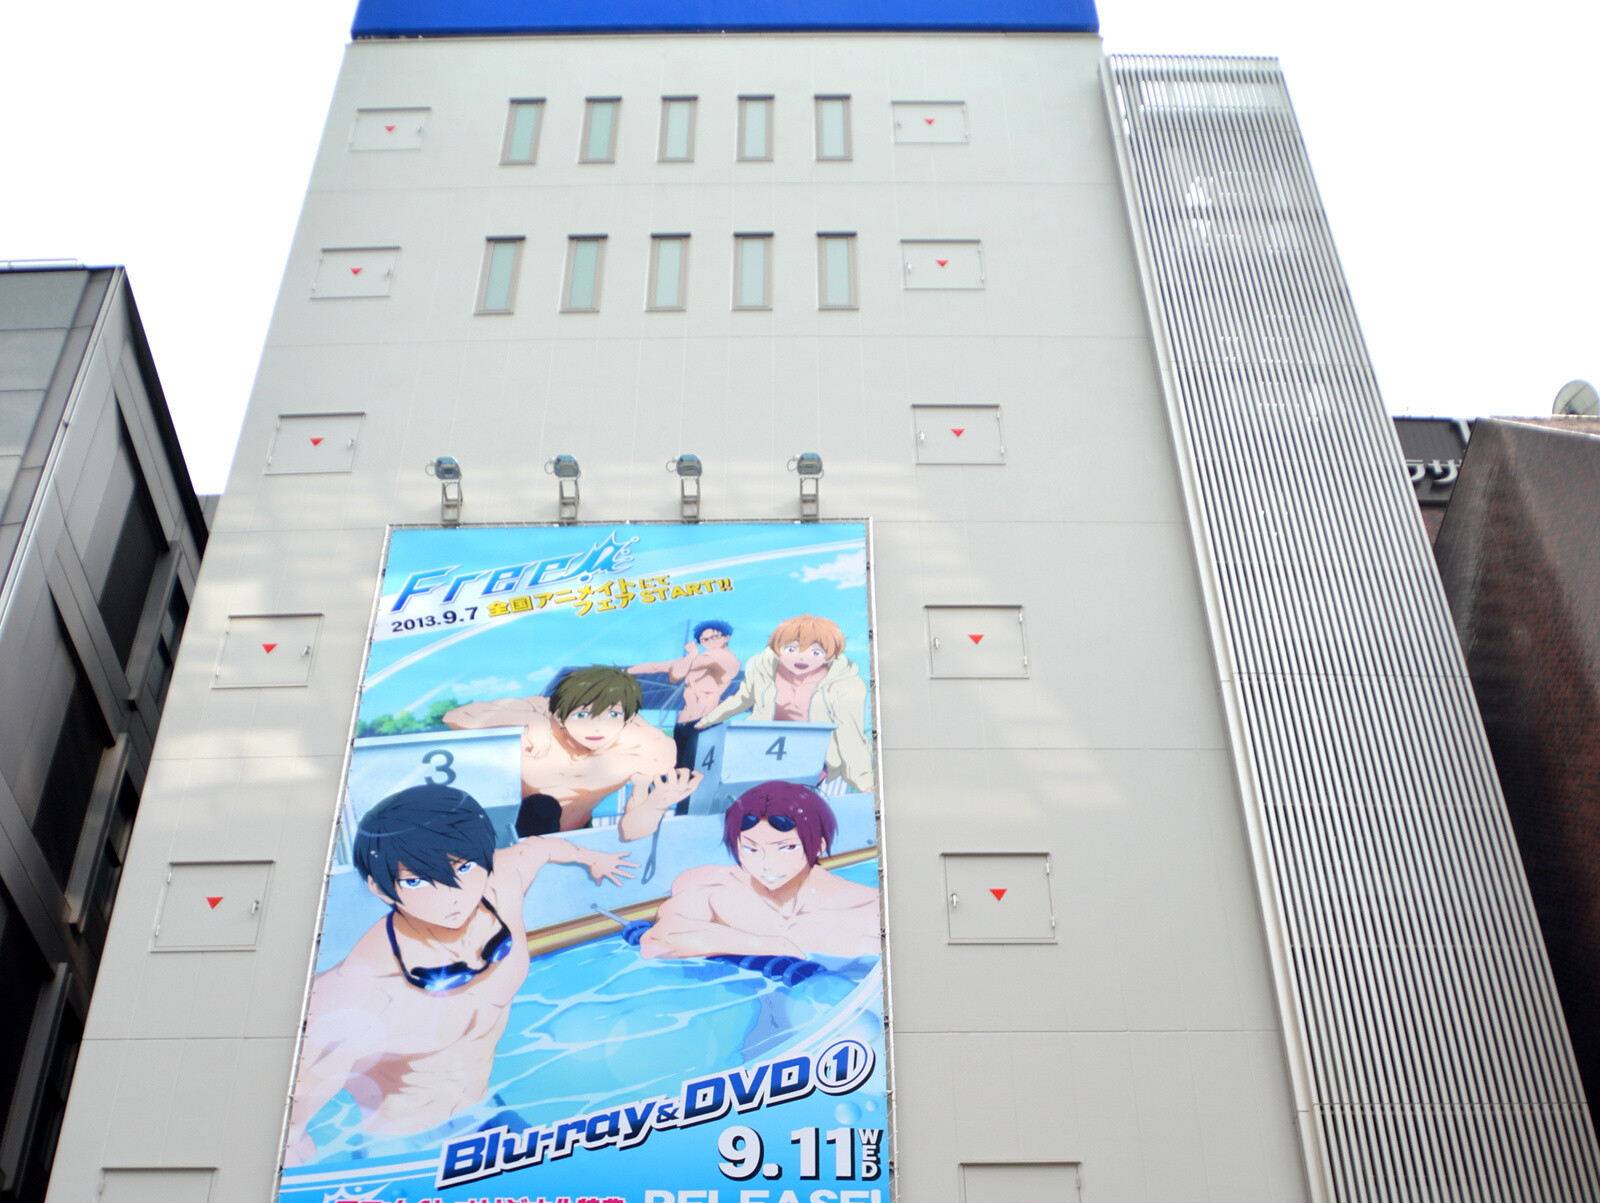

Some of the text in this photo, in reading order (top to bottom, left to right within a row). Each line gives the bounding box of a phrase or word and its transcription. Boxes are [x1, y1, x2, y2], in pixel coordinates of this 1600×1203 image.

[487, 575, 671, 617] 全国アニメイトにて
[391, 606, 478, 632] 2013.9.7
[701, 745, 716, 771] 4
[765, 736, 789, 761] 4
[421, 750, 456, 787] 3
[718, 1126, 857, 1179] 9.11
